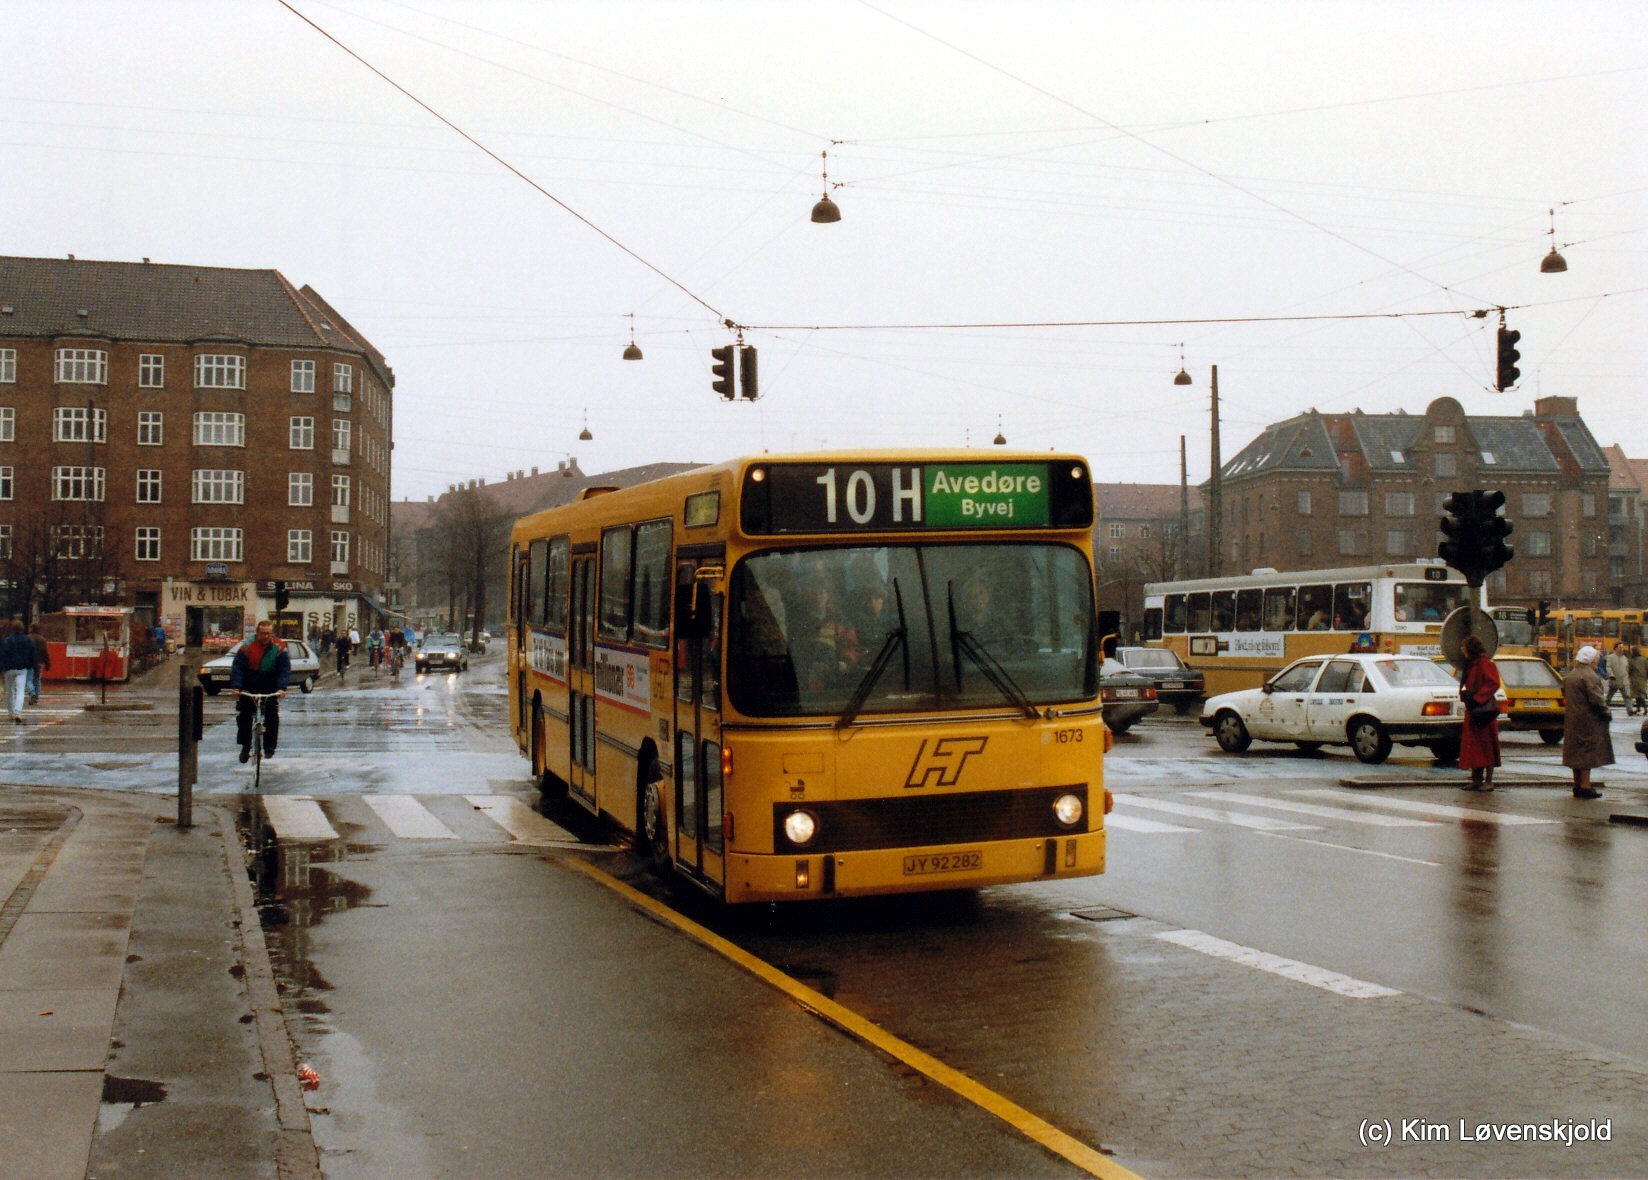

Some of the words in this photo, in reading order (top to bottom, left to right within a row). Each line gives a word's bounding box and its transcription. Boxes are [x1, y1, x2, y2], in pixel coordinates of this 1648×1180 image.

[931, 470, 1042, 496] Avedøre
[815, 467, 877, 525] 10
[891, 467, 922, 523] H
[961, 498, 1015, 520] Byvej
[171, 586, 192, 602] VIN
[196, 587, 206, 602] &
[209, 586, 249, 602] TOBAK
[267, 581, 314, 591] SLINA
[332, 582, 354, 591] SKO
[1053, 728, 1084, 745] 1673
[906, 857, 929, 873] JY
